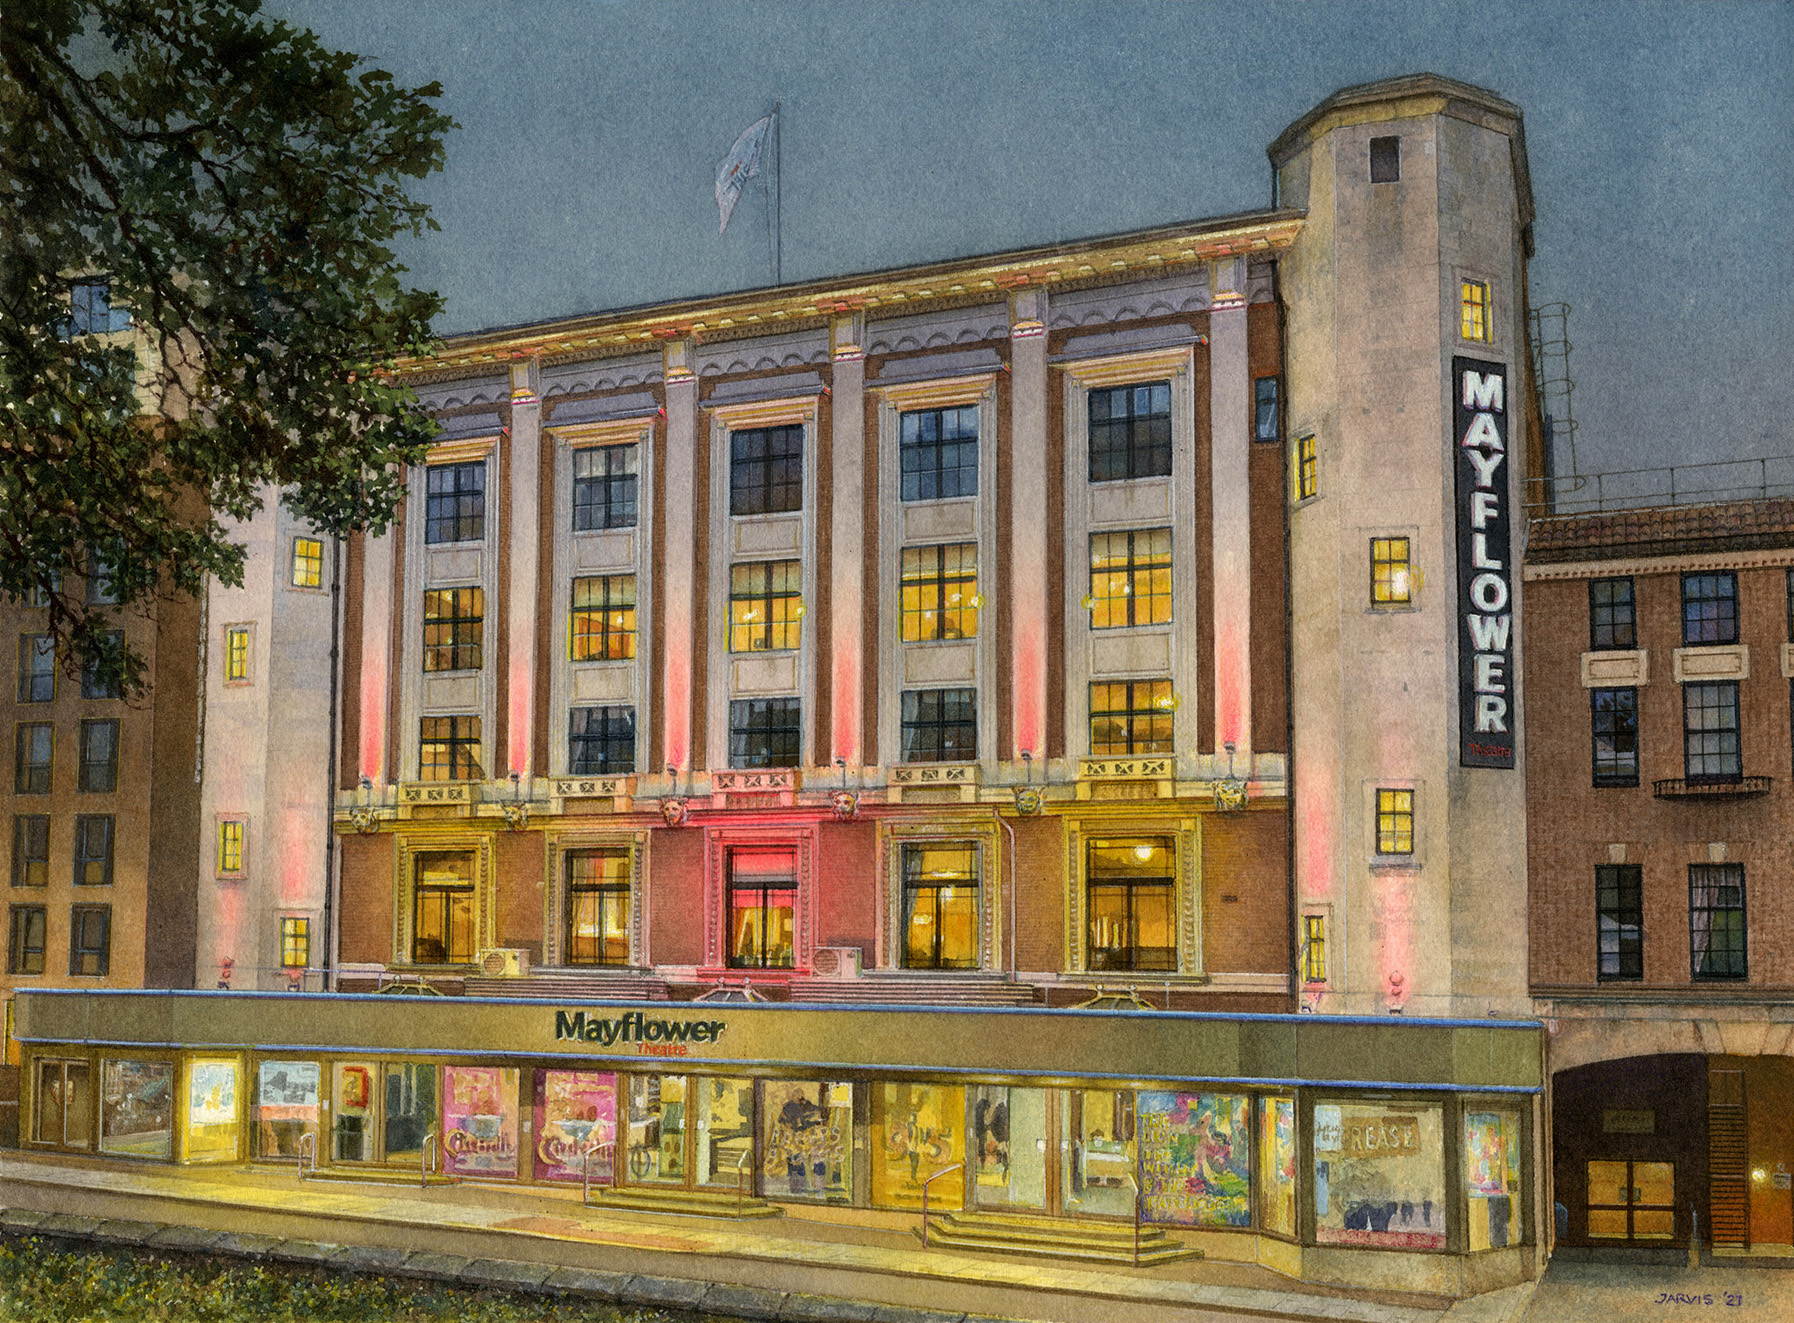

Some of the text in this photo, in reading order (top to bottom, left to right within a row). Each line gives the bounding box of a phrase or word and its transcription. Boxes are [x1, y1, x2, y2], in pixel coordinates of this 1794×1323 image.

[1462, 370, 1511, 733] MAYFLOWER
[556, 1010, 728, 1047] Mayflower
[636, 1043, 688, 1056] Theatre
[1654, 1293, 1713, 1305] JARVIS
